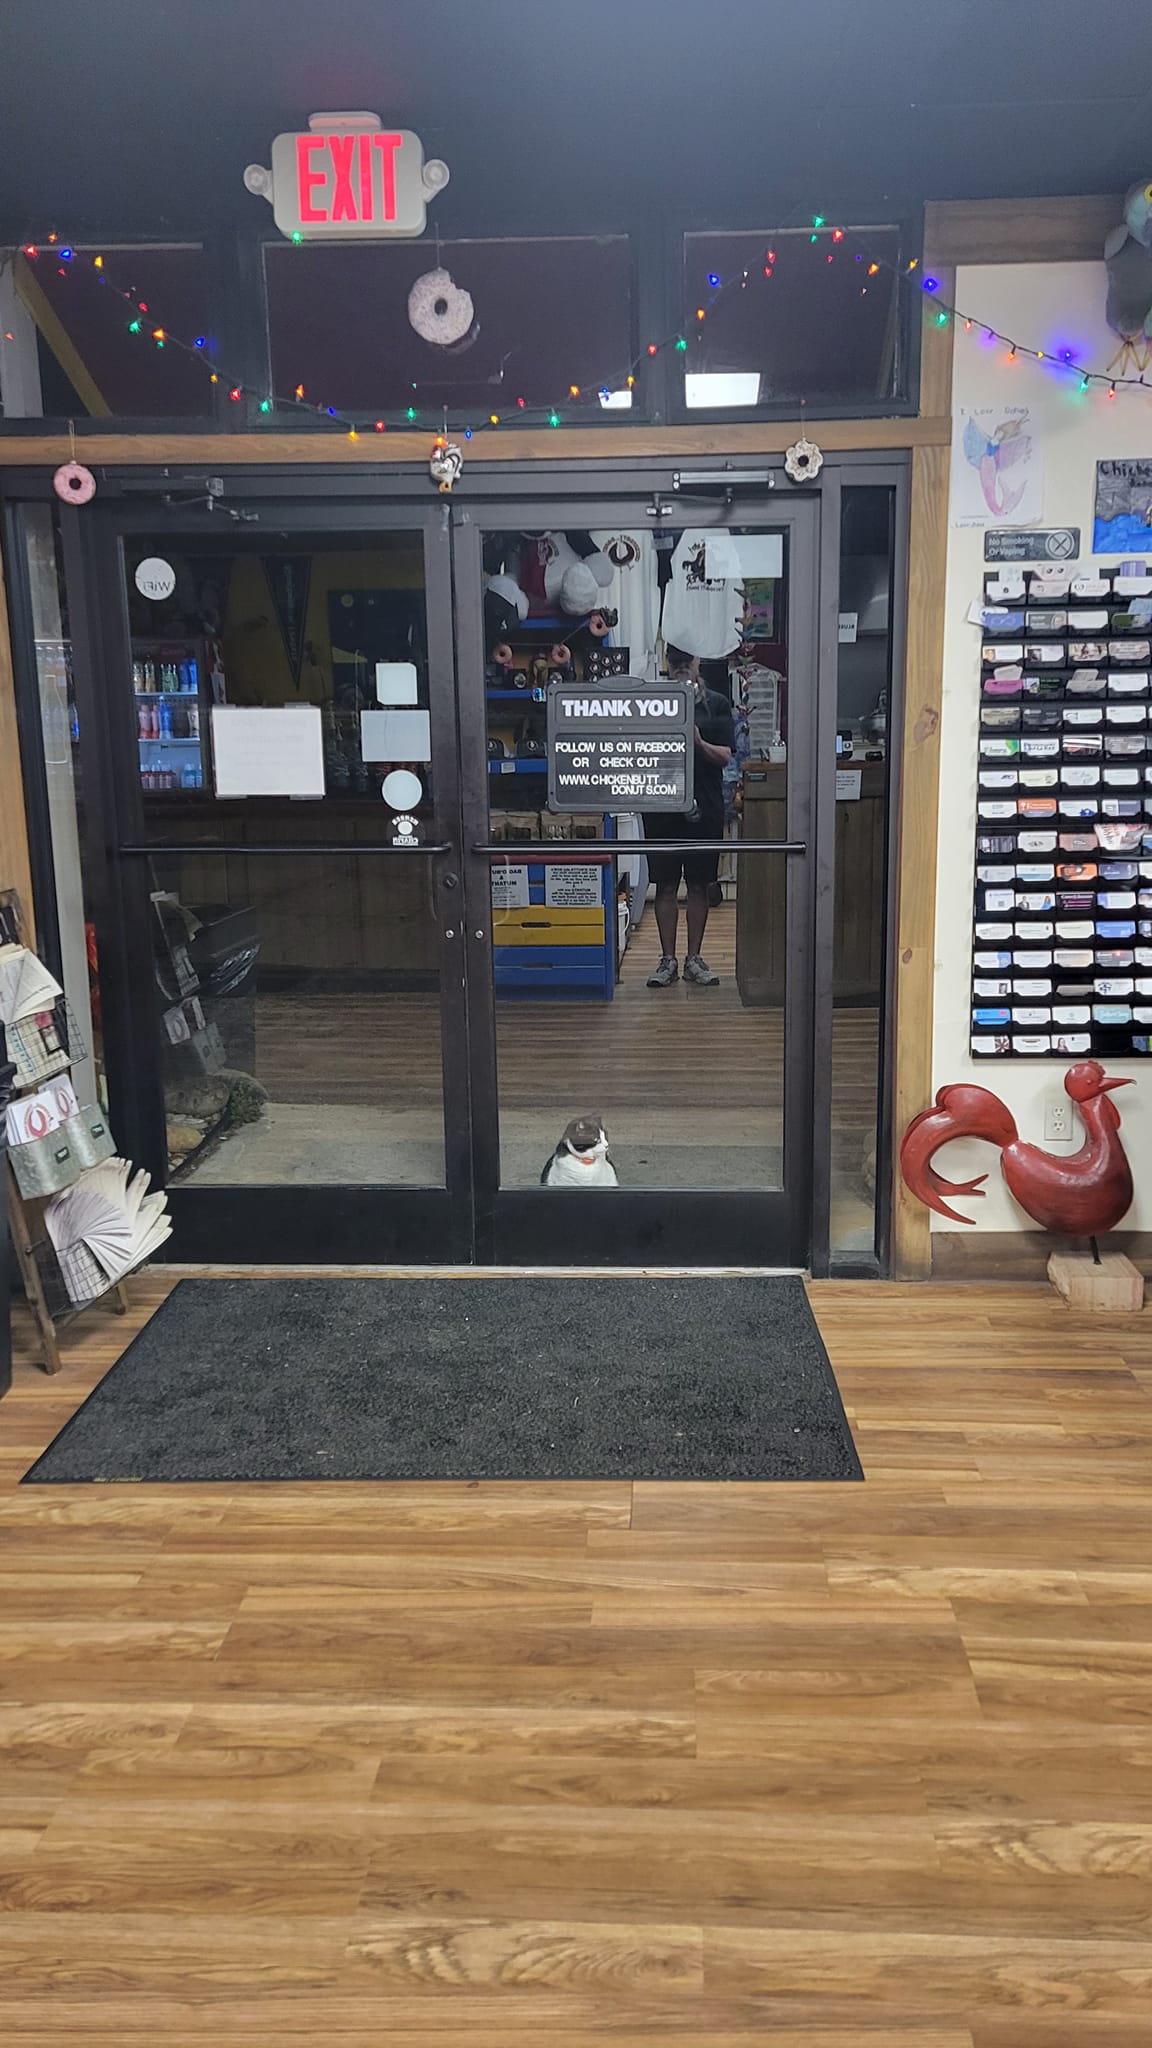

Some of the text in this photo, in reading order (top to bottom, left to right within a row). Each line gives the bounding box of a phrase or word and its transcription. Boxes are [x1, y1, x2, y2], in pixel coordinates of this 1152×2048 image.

[296, 134, 402, 223] EXIT
[1100, 460, 1152, 477] Chicke
[988, 535, 1035, 547] No Smoking
[562, 699, 679, 717] THANK YOU
[555, 741, 686, 753] FOLLOW US ON FACEBOOK
[572, 756, 660, 768] OR CHECK OUT
